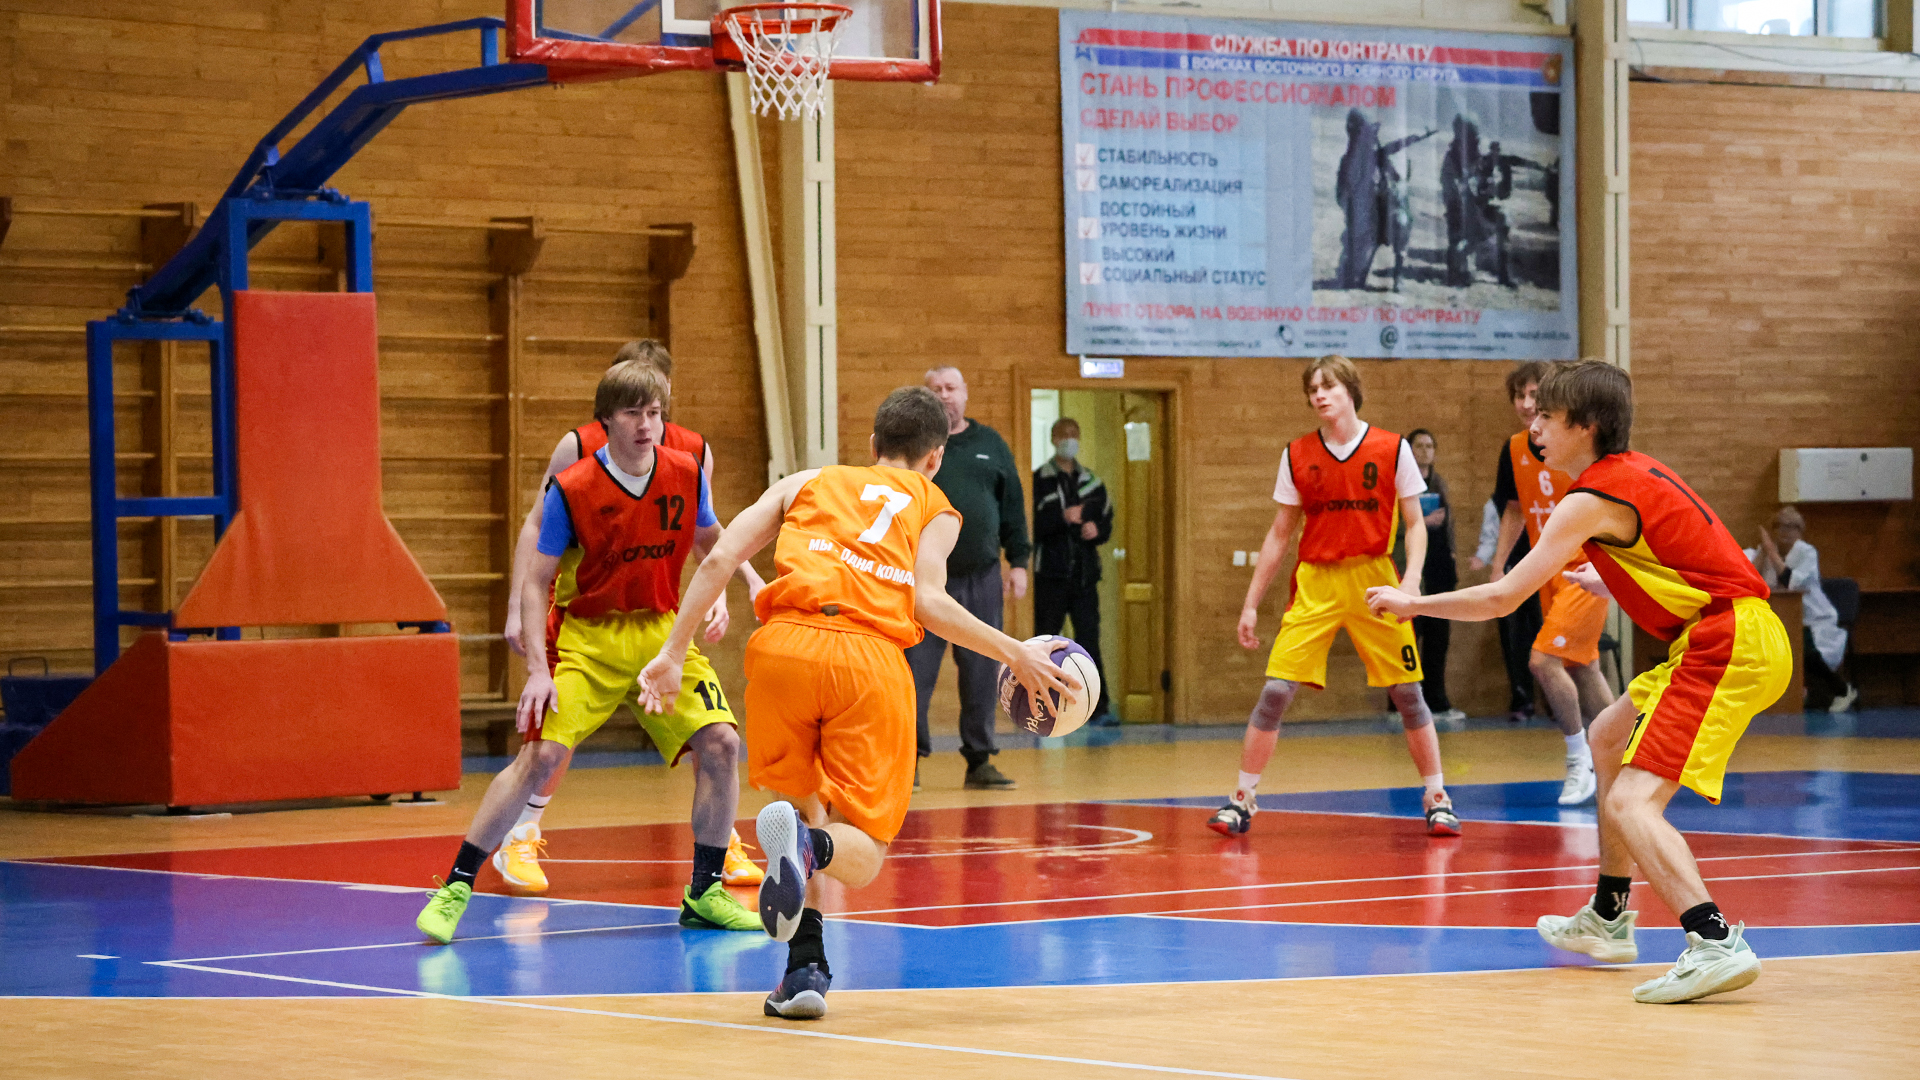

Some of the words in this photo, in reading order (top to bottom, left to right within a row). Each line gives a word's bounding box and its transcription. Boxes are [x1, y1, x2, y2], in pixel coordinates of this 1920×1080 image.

[1210, 34, 1292, 57] СЛУЖБА
[1295, 37, 1323, 58] ПО
[1327, 40, 1433, 64] КОНТРАКТУ
[1180, 55, 1189, 69] В
[1254, 58, 1340, 77] ВОСТОЧНОГО
[1343, 63, 1412, 80] ВОЕННОГО
[1414, 66, 1460, 83] ОКРУГА
[1080, 72, 1159, 98] СТАНЬ
[1166, 76, 1396, 107] ПРОФЕССИОНАЛОМ
[1080, 106, 1161, 130] СДЕЛАЙ
[1166, 111, 1239, 133] ВЫБОР
[1098, 148, 1218, 167] СТАБИЛЬНОСТЬ
[1099, 175, 1243, 195] САМОРЕАЛИЗАЦИЯ
[1100, 200, 1196, 218] ДОСТОЙНЫЙ
[1101, 222, 1170, 239] УРОВЕНЬ
[1174, 224, 1227, 240] ЖИЗНИ
[1102, 245, 1175, 262] ВЫСОКИЙ
[1103, 266, 1208, 285] СОЦИАЛЬНЫЙ
[1212, 269, 1267, 286] СТАТУС
[1082, 301, 1130, 318] ПУНКТ
[1135, 303, 1196, 319] ОТБОРА
[1200, 305, 1223, 320] НА
[1226, 306, 1304, 322] ВОЕННУЮ
[1306, 306, 1367, 323] СЛУЖБУ
[1372, 308, 1397, 324] ПО
[1362, 462, 1378, 490] 9
[1538, 470, 1554, 496] 6
[654, 494, 685, 531] 12
[857, 483, 913, 545] 7
[808, 538, 832, 551] МЫ
[840, 548, 874, 573] ОДНА
[1401, 644, 1417, 672] 9
[693, 679, 728, 712] 12
